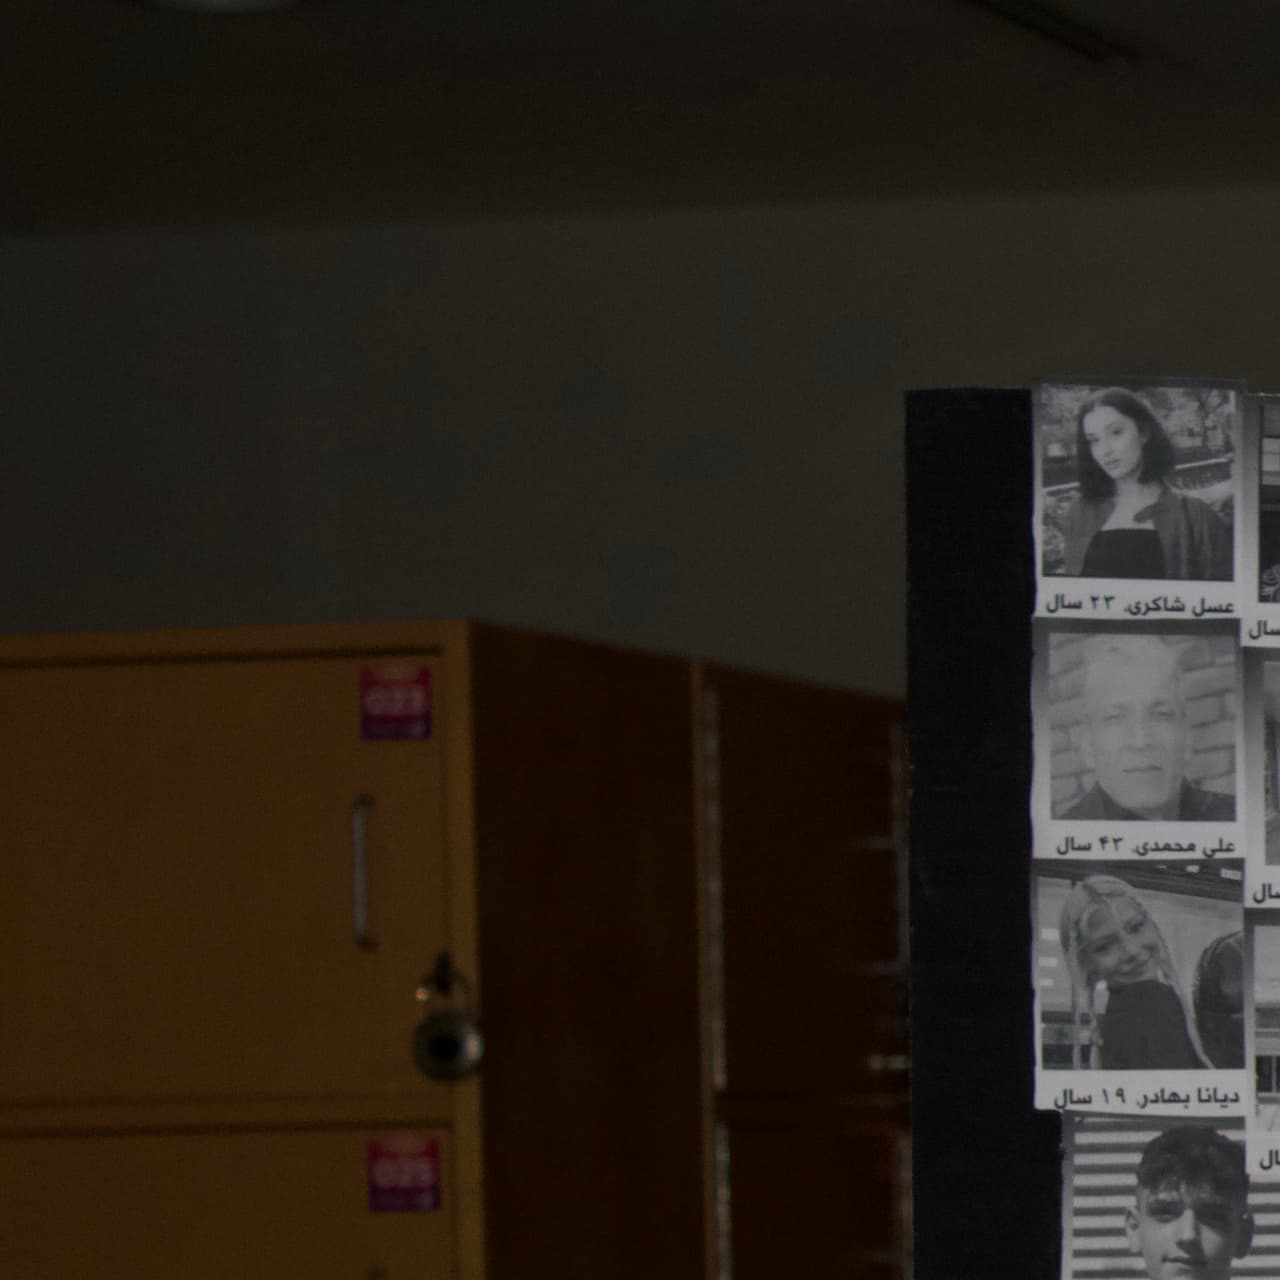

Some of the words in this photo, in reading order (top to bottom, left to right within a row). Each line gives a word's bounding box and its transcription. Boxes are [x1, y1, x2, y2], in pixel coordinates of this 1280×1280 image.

[1054, 1088, 1092, 1109] سال
[1102, 1088, 1126, 1104] ۱۹
[1197, 1088, 1240, 1103] دیانا
